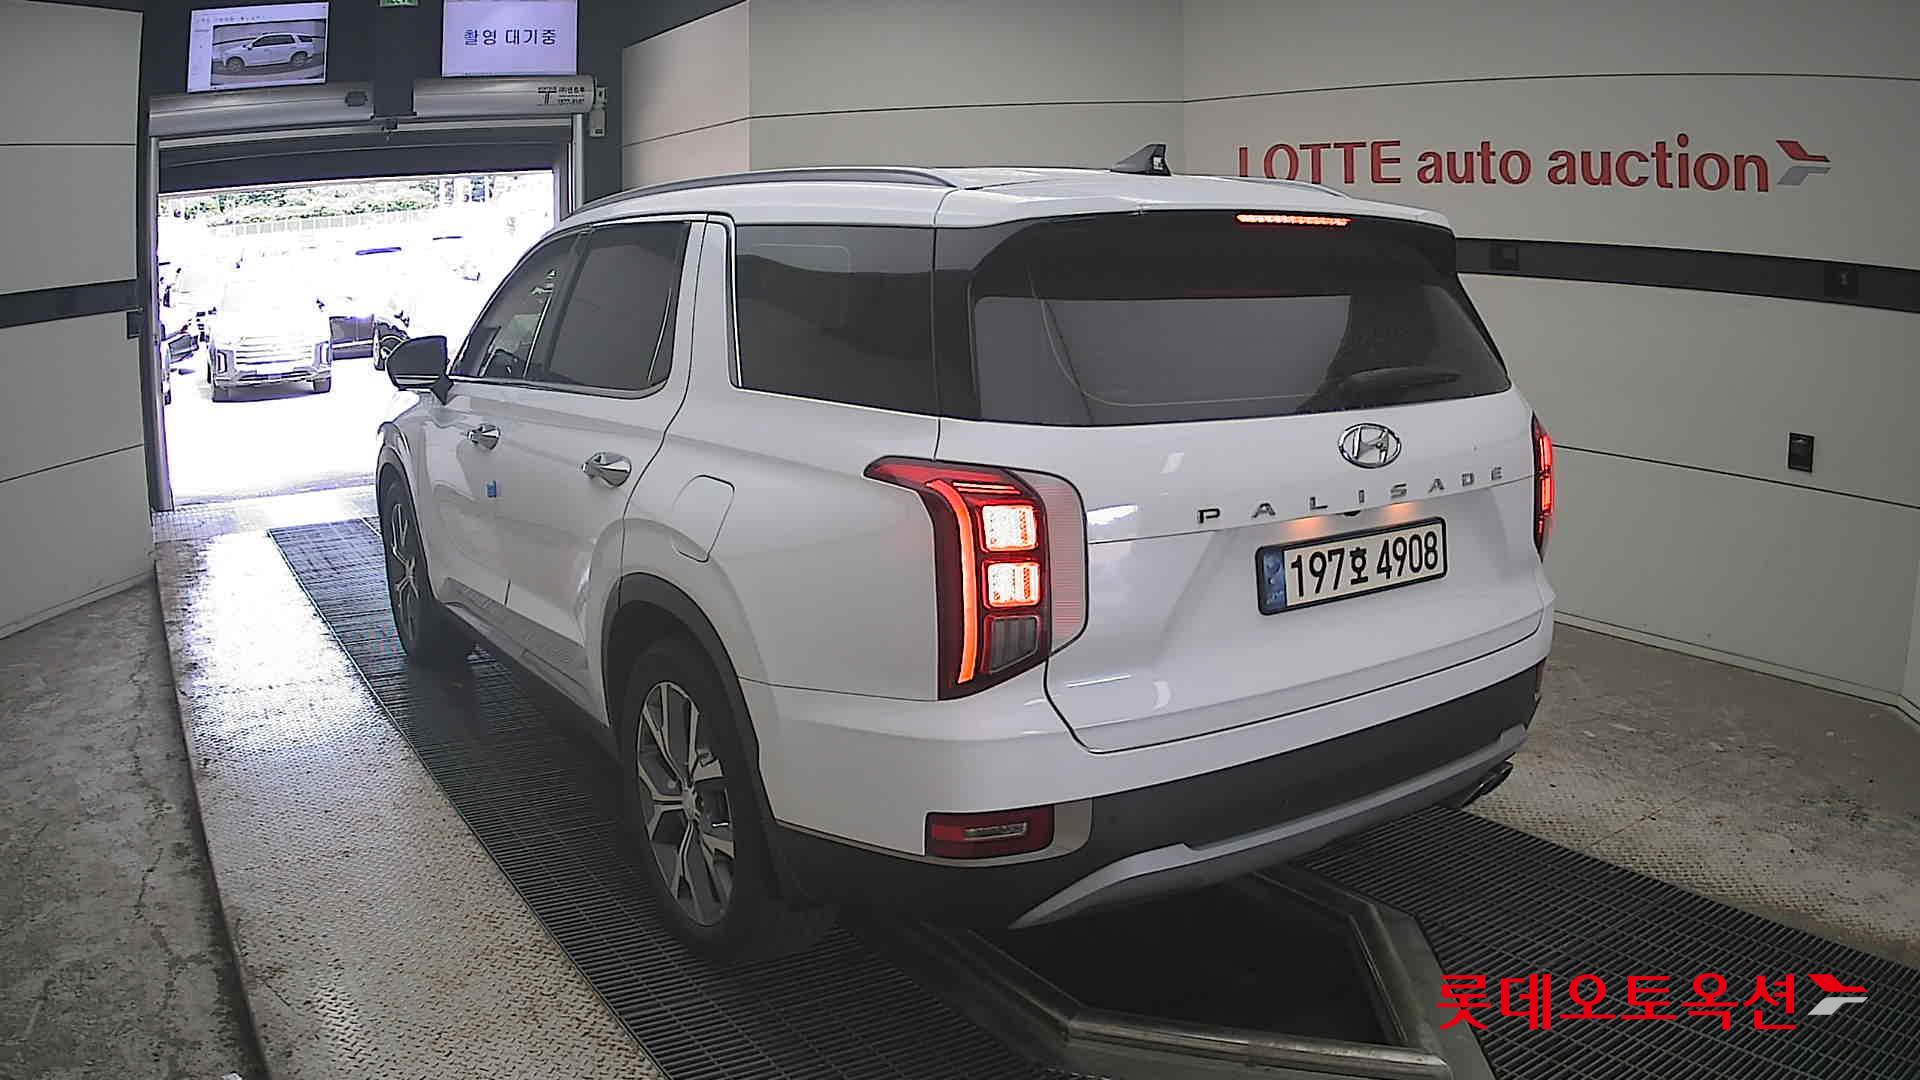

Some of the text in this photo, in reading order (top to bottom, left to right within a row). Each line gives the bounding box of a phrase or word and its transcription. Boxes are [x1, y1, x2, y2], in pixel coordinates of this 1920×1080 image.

[464, 28, 557, 46] 촬영 대기중
[1417, 141, 1532, 186] auto
[1548, 134, 1769, 192] auction
[1198, 467, 1503, 524] PALISADE
[1376, 531, 1439, 580] 4908
